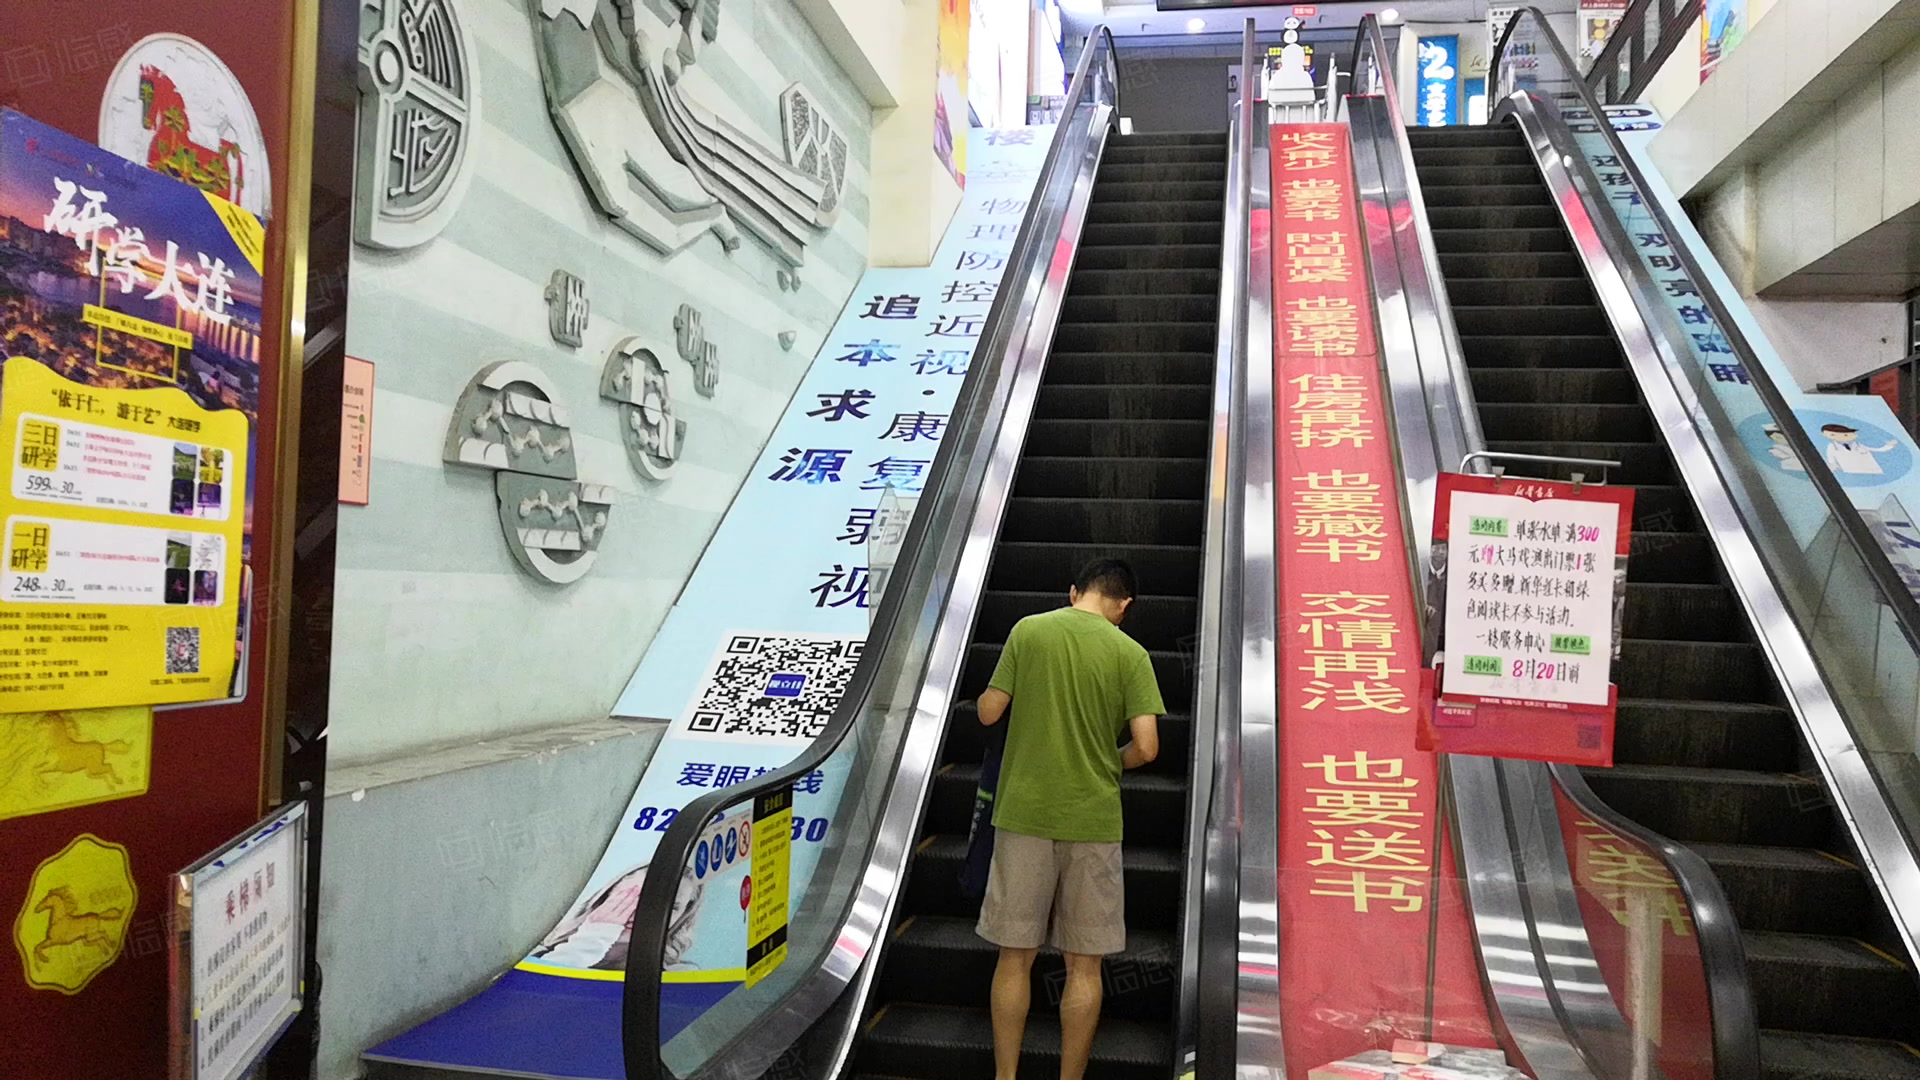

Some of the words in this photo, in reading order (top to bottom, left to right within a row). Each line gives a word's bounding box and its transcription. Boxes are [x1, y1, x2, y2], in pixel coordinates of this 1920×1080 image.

[1281, 132, 1338, 170] 收入再少
[1282, 178, 1342, 221] 也要买书
[44, 176, 234, 327] 研学大连
[1285, 231, 1352, 282] 时间再紧
[1285, 295, 1359, 356] 也要读书
[767, 294, 921, 486] 追本求源
[1289, 373, 1374, 448] 住房再挤
[22, 422, 58, 447] 三日
[20, 447, 59, 469] 研学
[25, 474, 51, 492] 599
[61, 481, 75, 495] 30
[13, 527, 48, 547] 一日
[1292, 469, 1388, 562] 也要藏书
[10, 548, 48, 571] 研学
[13, 576, 39, 593] 248
[51, 579, 66, 592] 30
[1298, 591, 1410, 714] 交情再浅
[676, 761, 825, 795] 爱眼线
[1302, 751, 1430, 912] 也要送书
